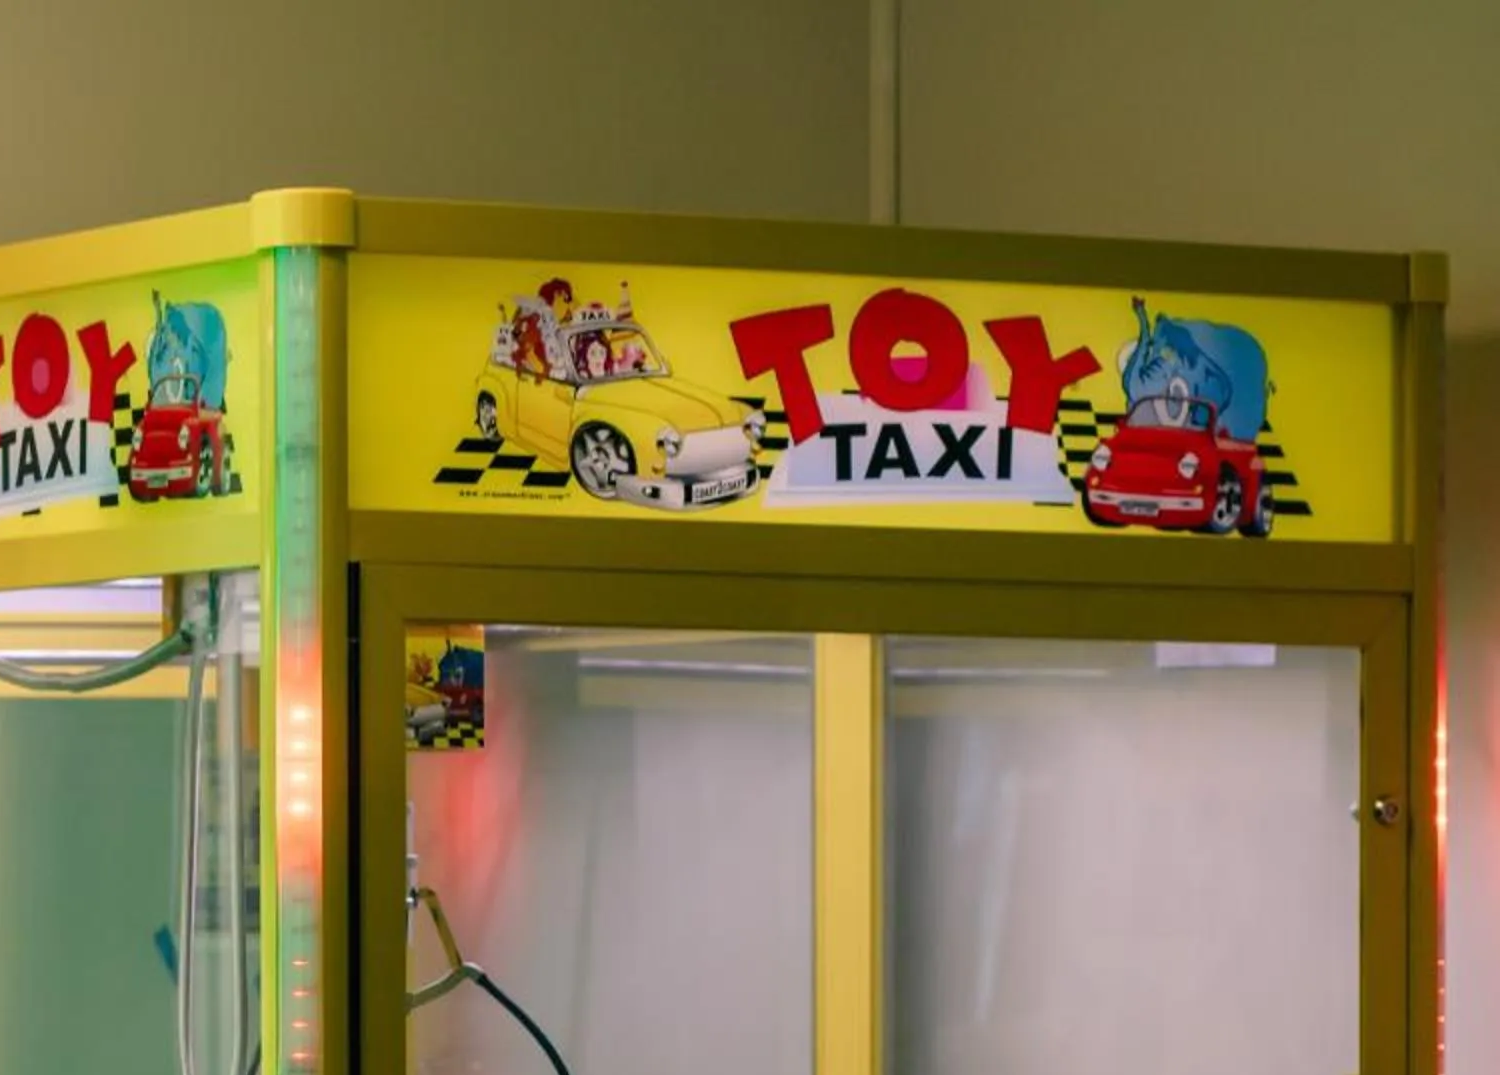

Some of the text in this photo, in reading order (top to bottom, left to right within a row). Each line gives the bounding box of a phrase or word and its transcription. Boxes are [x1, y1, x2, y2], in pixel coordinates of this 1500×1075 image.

[729, 286, 1102, 446] TOY
[0, 418, 87, 492] TAXI
[820, 422, 1013, 481] TAXI
